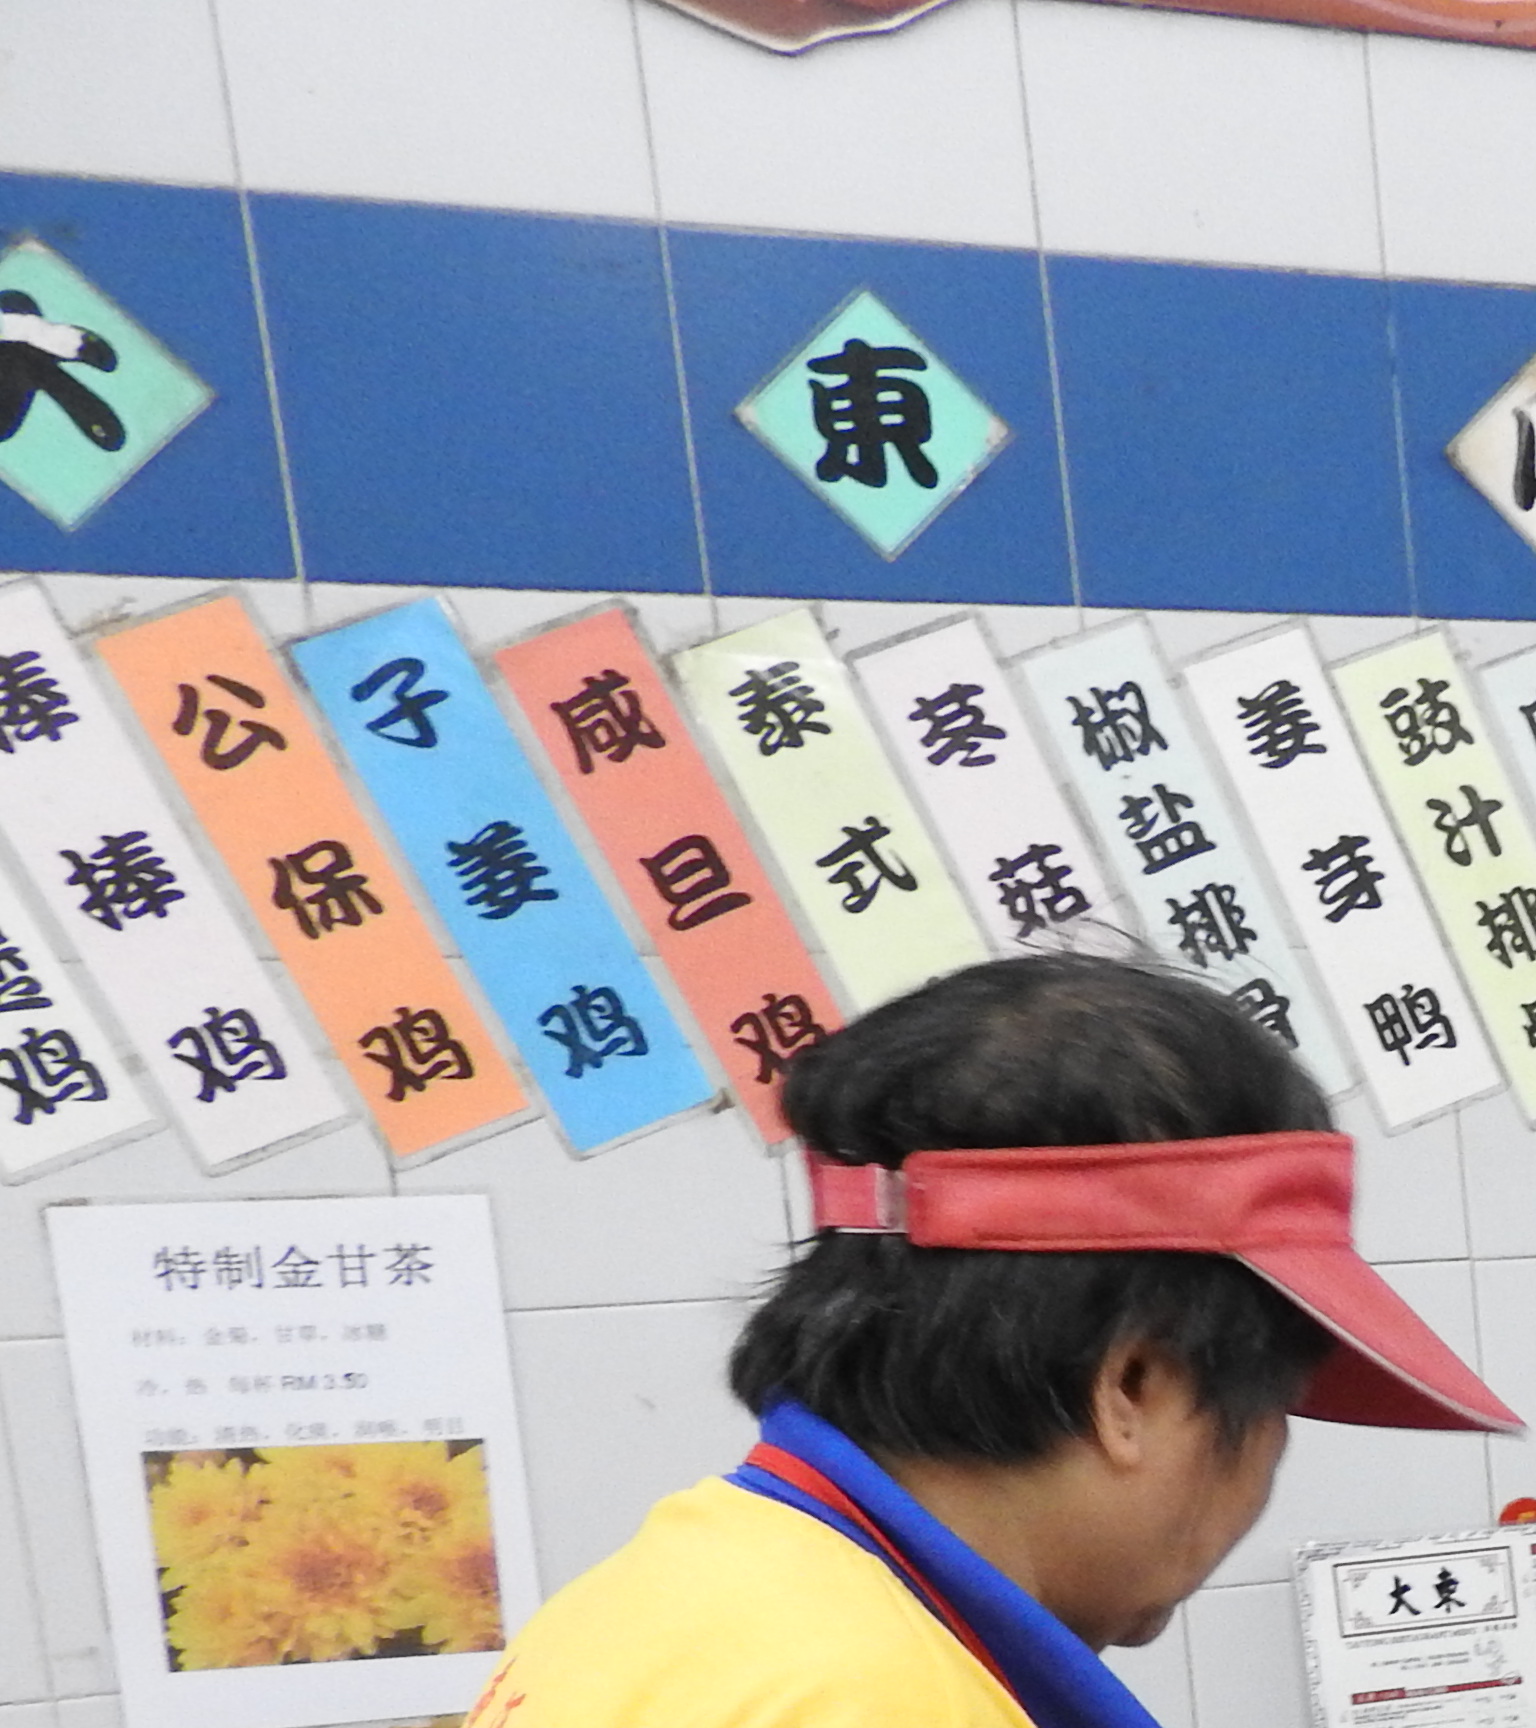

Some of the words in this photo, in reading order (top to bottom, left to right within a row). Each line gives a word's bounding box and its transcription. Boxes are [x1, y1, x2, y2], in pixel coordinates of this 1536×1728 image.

[808, 340, 939, 490] 東
[172, 674, 475, 1102] 公保鸡
[153, 1242, 436, 1292] 特制金甘茶
